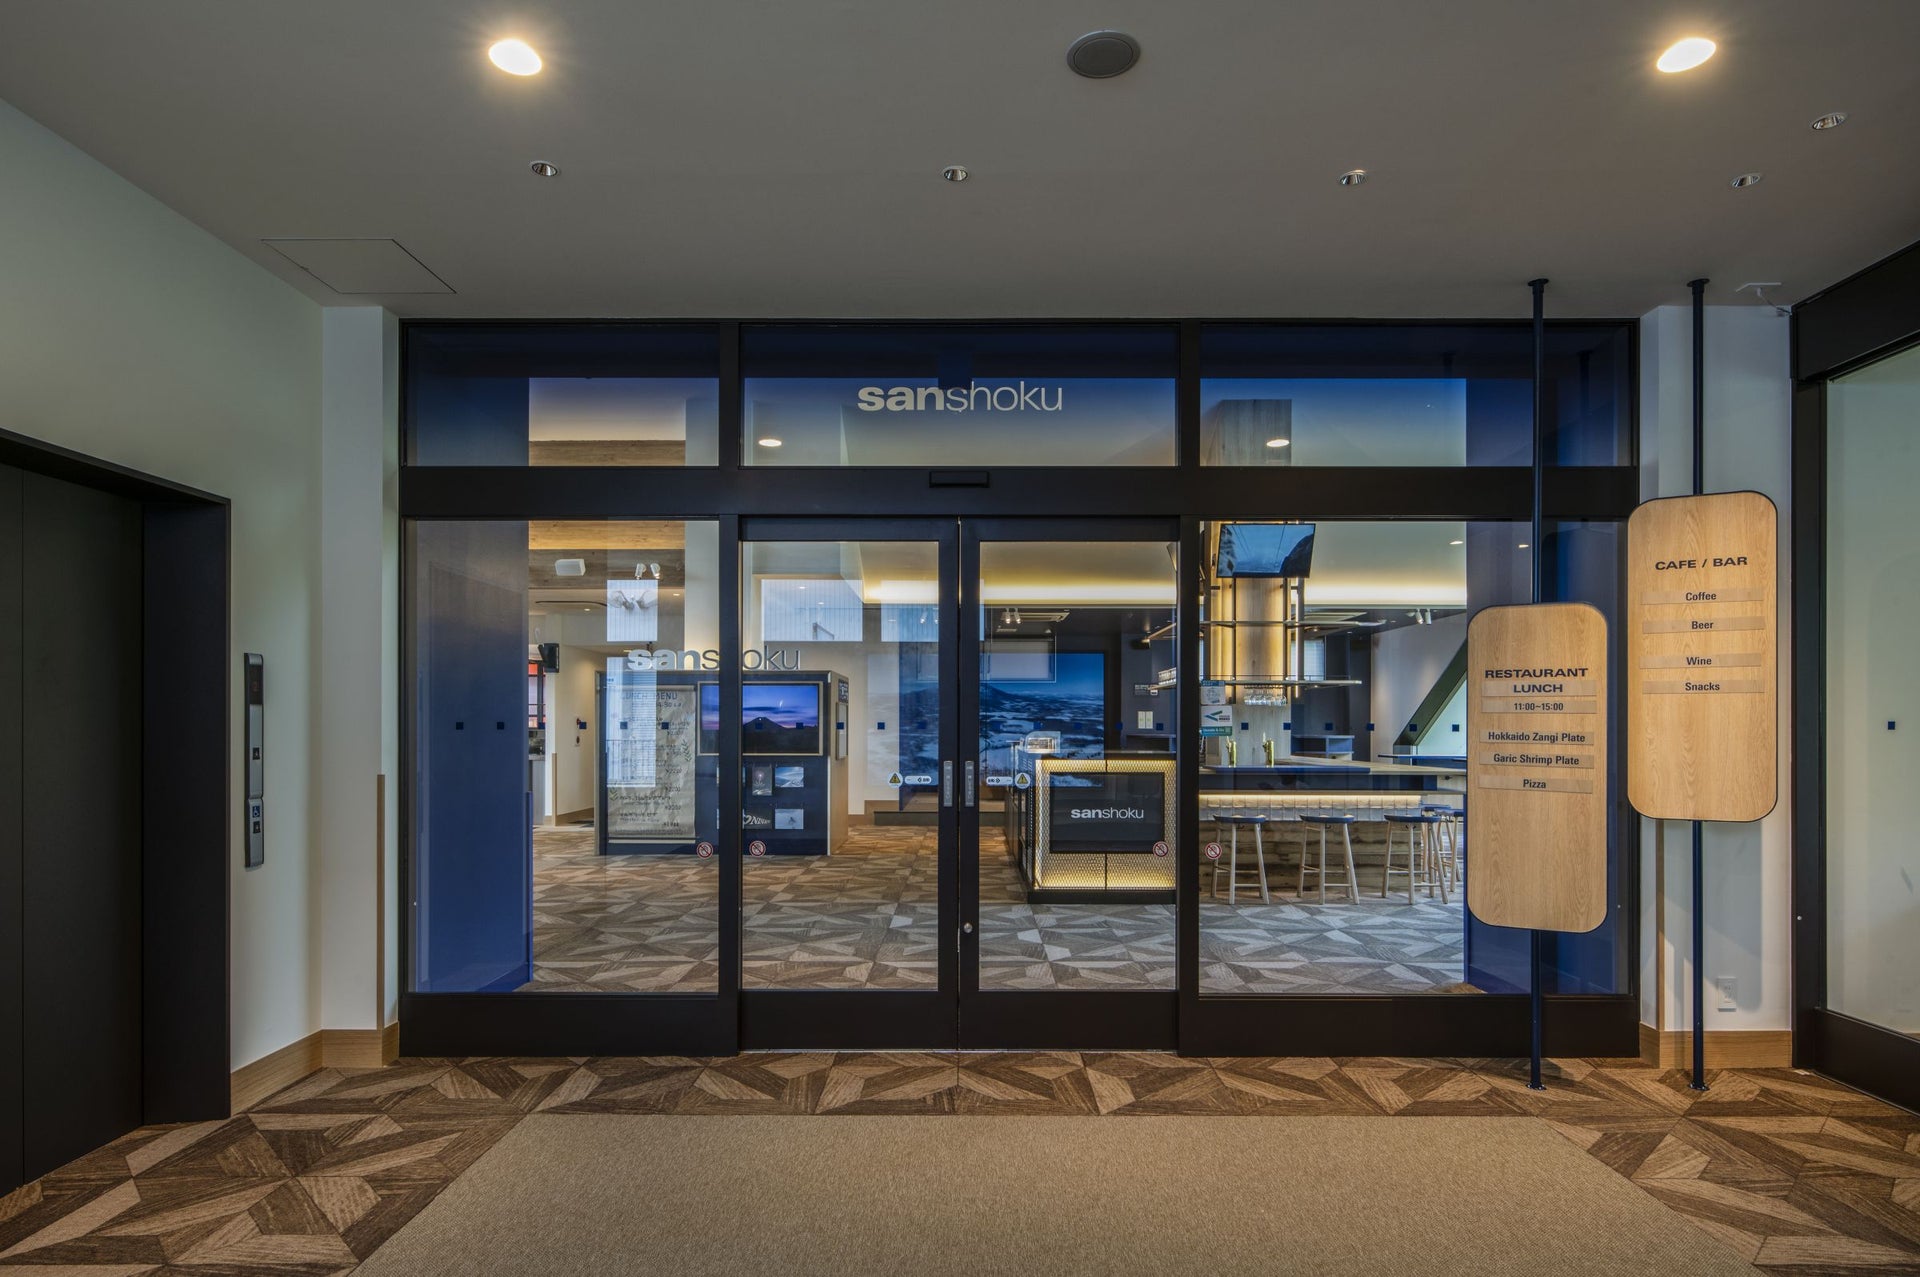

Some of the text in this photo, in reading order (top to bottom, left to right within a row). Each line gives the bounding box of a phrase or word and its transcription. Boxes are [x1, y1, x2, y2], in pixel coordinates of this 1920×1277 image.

[857, 380, 1063, 412] sanshoku
[1655, 559, 1697, 571] CAFE
[1713, 556, 1748, 567] BAR
[1685, 591, 1717, 601] Coffee
[1691, 620, 1714, 630] Beer
[627, 644, 801, 671] sansoku
[1686, 656, 1712, 666] Wine
[1485, 667, 1589, 679] RESTAURANT
[1513, 683, 1564, 693] LUNCH
[1685, 681, 1720, 691] Snacks
[1488, 731, 1586, 743] Hokkaido Zangi Plate
[1493, 753, 1580, 766] Garic Shrimp Plate
[1523, 779, 1547, 789] Pizza
[1070, 807, 1144, 819] sanshoku
